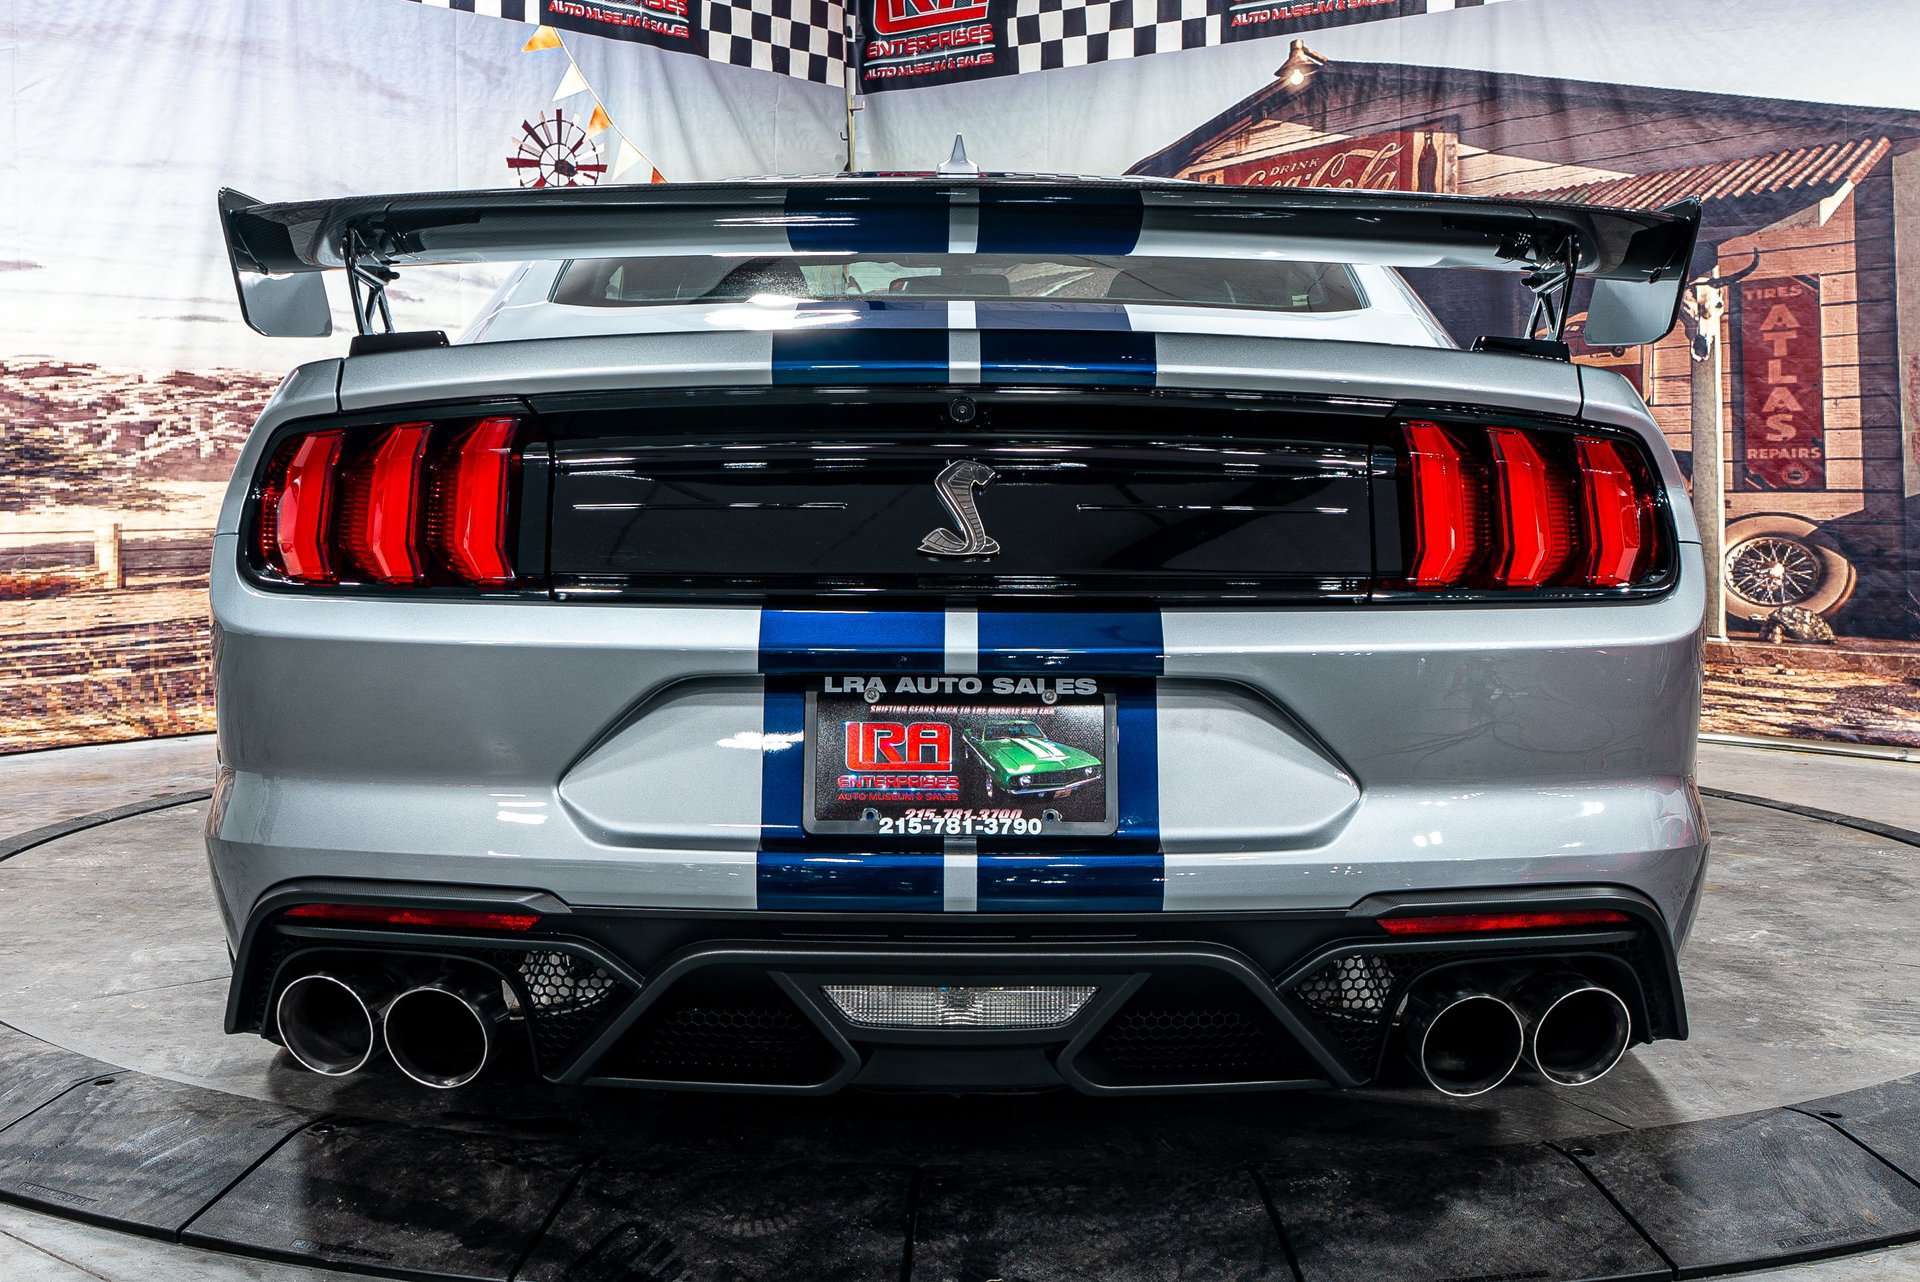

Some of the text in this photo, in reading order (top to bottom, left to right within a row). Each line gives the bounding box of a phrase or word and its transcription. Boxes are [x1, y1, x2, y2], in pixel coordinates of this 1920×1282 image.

[548, 0, 584, 16] AUTO
[586, 7, 641, 28] MUSEUM
[642, 16, 651, 30] &
[651, 20, 690, 38] SALES
[1231, 10, 1270, 27] AUTO
[1271, 1, 1334, 20] MUSEUM
[866, 24, 994, 59] ENTERPRISES
[864, 52, 995, 80] AUTO MUSEUM & SALES
[1242, 142, 1408, 190] a-Cola
[1269, 158, 1321, 176] DRINK
[1743, 285, 1803, 301] TIRES
[1759, 303, 1804, 442] ATLAS
[1747, 446, 1822, 460] REPAIRS
[824, 676, 1098, 695] LRA AUTO SALES
[844, 721, 953, 772] LRA
[837, 775, 960, 789] ENTERPRISES
[837, 792, 959, 801] AUTO MUSEUM & SALES
[878, 817, 1042, 835] 215-781-3790
